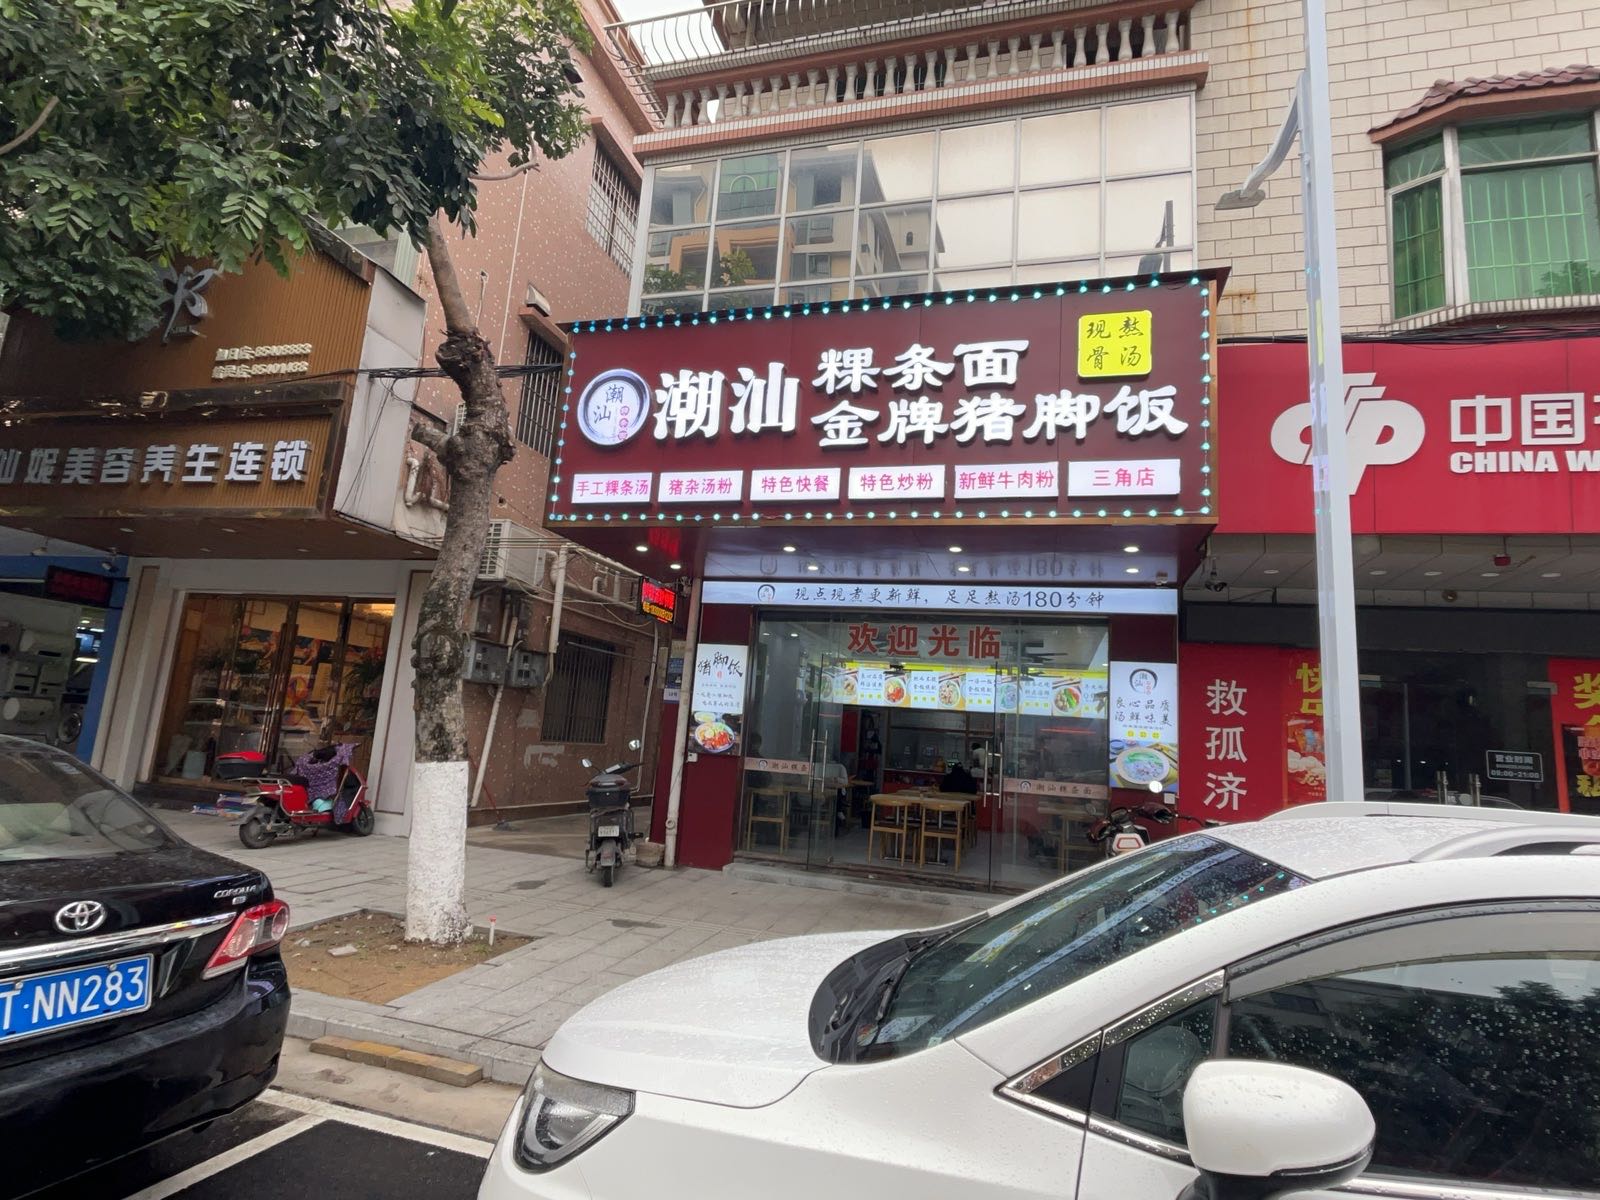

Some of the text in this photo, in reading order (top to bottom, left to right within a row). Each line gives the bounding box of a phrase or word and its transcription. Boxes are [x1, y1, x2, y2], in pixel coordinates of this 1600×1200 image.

[812, 338, 1029, 393] 粿条面
[1086, 344, 1143, 371] 骨汤
[653, 361, 800, 440] 潮汕
[810, 384, 1189, 447] 金牌猪脚饭
[1450, 392, 1600, 447] 中国
[1450, 450, 1559, 473] CHINA
[576, 478, 650, 497] 手工粿条汤
[668, 477, 733, 496] 猪杂汤粉
[761, 474, 830, 494] 特色快餐
[860, 472, 933, 493] 特色炒粉
[958, 470, 1055, 490] 新鲜牛肉粉
[1092, 467, 1156, 488] 三角店
[847, 622, 1002, 660] 欢迎光临
[1203, 679, 1249, 825] 救孤济
